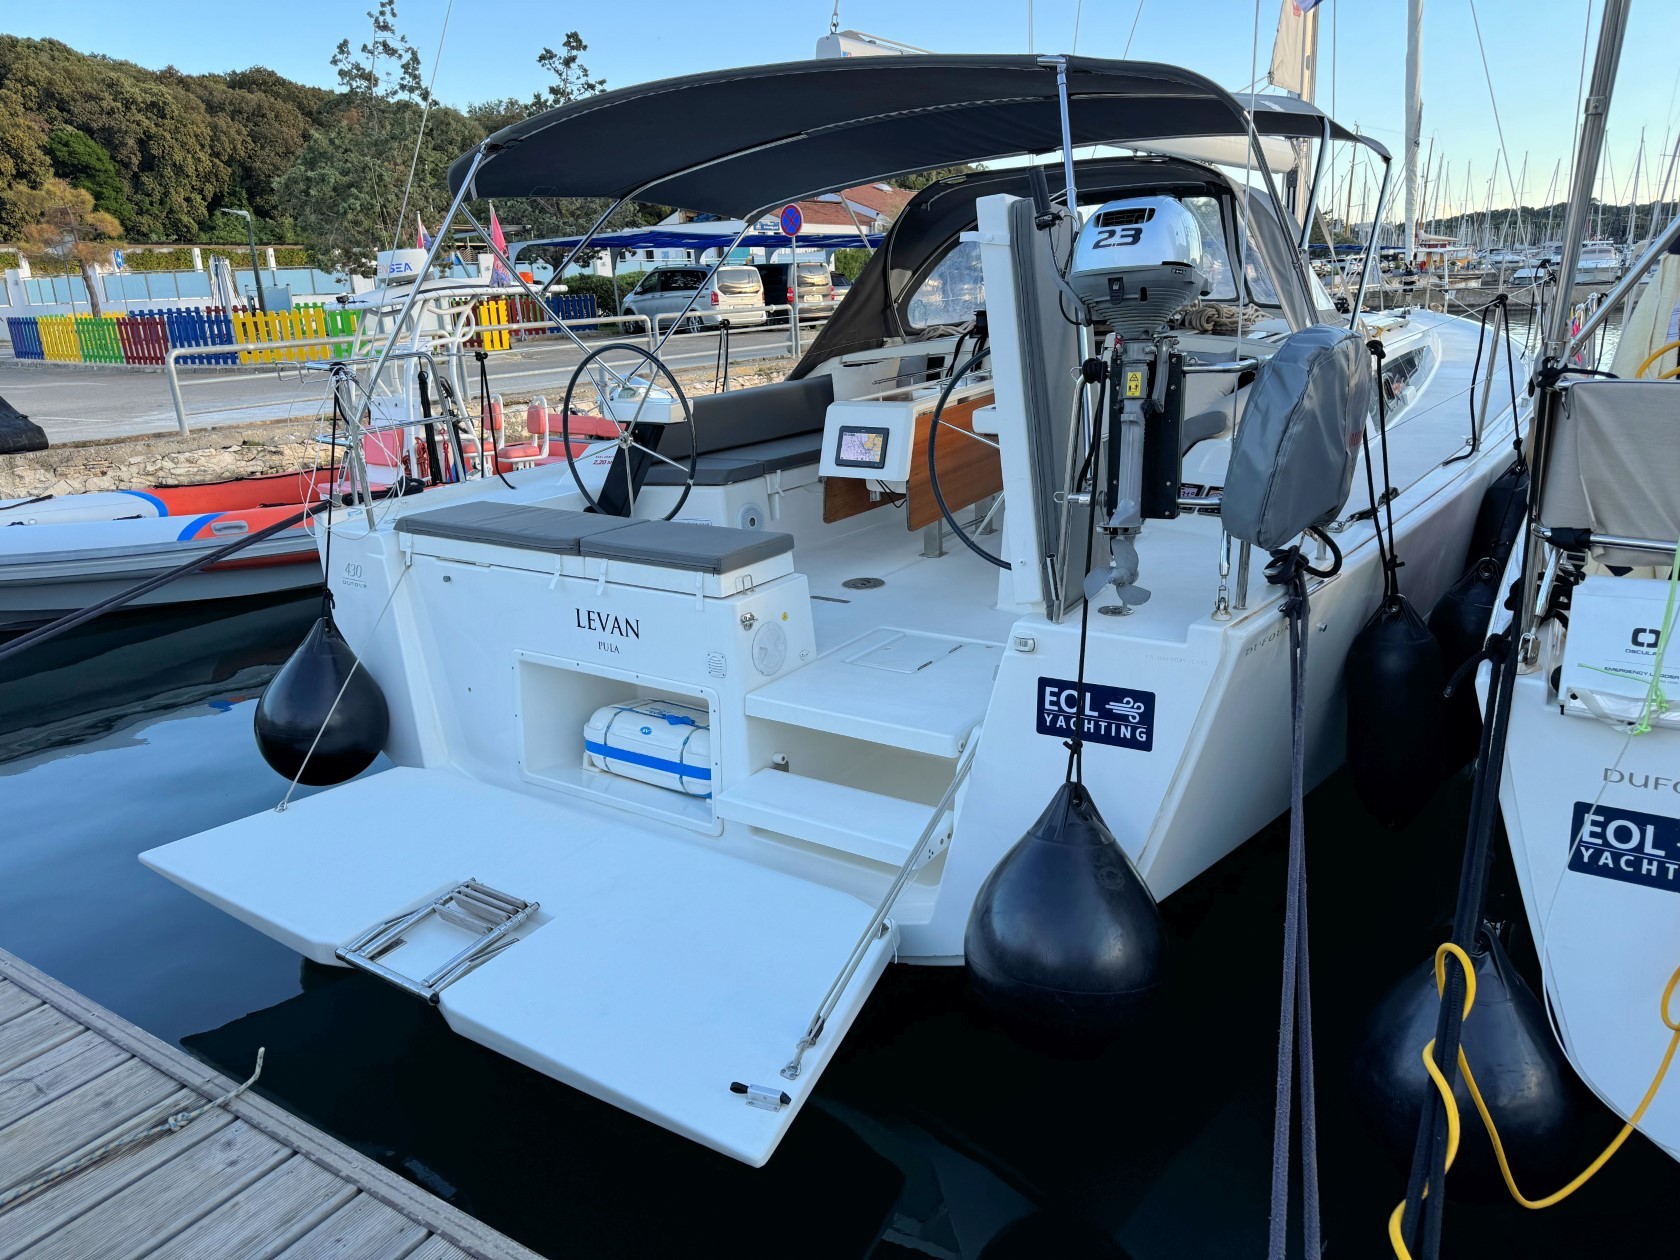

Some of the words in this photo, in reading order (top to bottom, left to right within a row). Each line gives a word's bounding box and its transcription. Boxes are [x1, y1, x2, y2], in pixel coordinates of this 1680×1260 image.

[344, 563, 363, 578] 430
[575, 607, 640, 640] LEVAN
[598, 641, 620, 654] PULA
[1604, 666, 1649, 676] EMERGENCY
[1649, 672, 1680, 680] LDDER
[1044, 686, 1099, 717] EOL
[1044, 713, 1147, 742] YACHTING
[1581, 813, 1666, 857] EOL
[1580, 846, 1679, 880] YACHT
